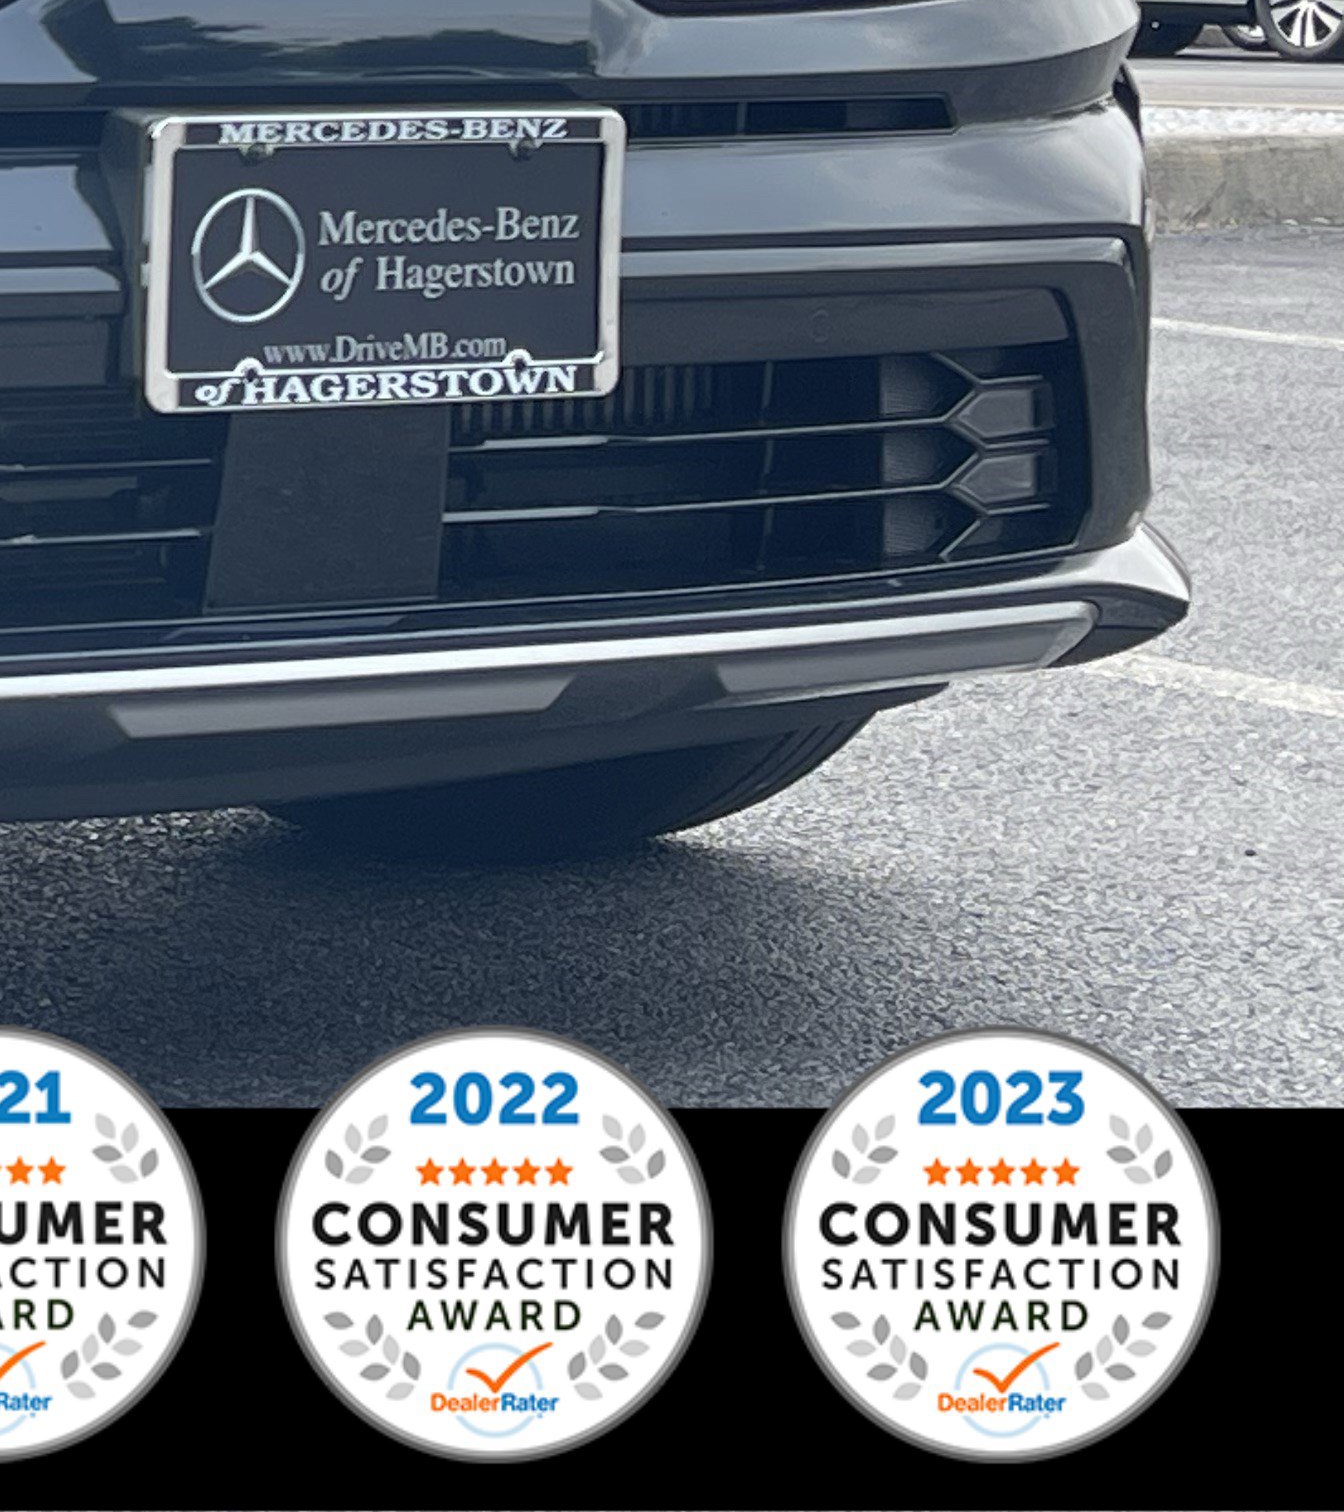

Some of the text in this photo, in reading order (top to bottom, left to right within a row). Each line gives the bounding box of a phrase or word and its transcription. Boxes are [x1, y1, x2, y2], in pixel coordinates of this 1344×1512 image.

[217, 117, 569, 145] MERCEDES-BENZ
[318, 207, 580, 246] Mercedes-Benz
[320, 255, 576, 300] of Hagerstown
[262, 333, 507, 365] www.DriveMB.com
[194, 365, 578, 406] of HAGERSTOWN
